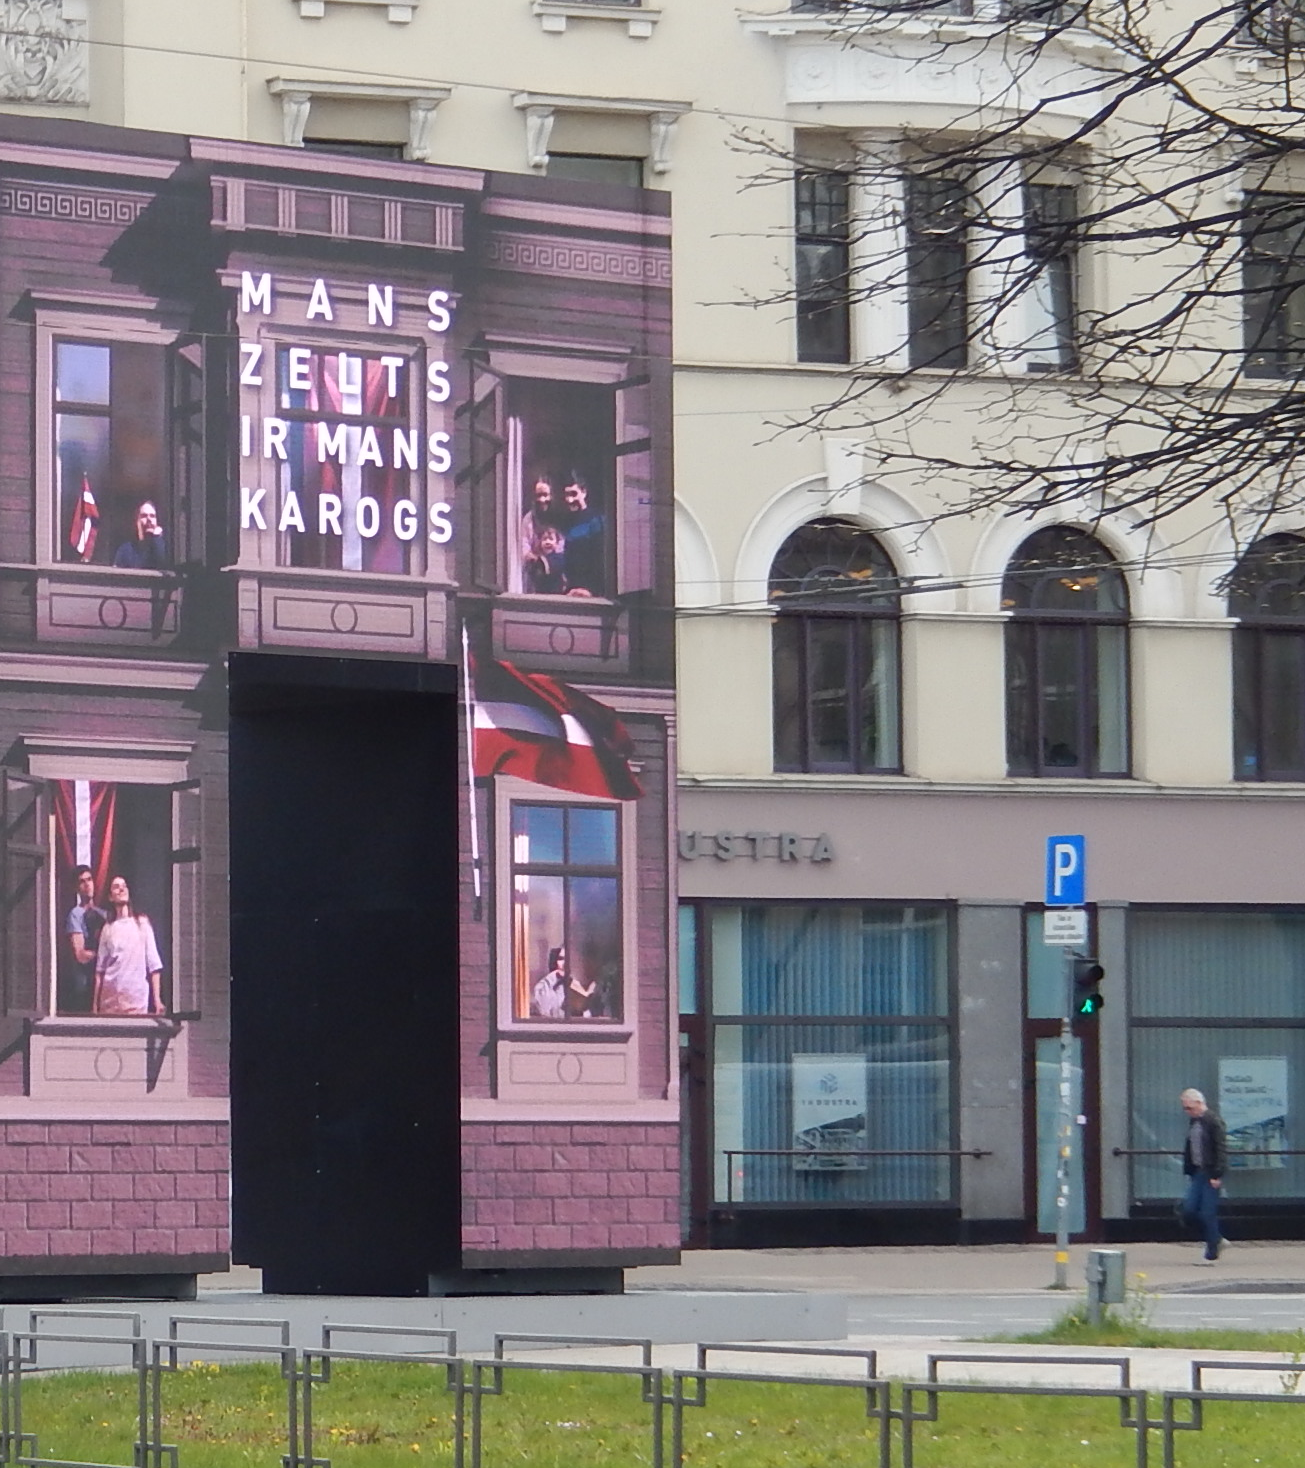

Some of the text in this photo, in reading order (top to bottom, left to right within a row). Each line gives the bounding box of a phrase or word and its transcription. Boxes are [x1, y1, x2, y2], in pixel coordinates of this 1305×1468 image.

[241, 271, 450, 331] MANS
[241, 343, 450, 402] ZELTS
[241, 415, 451, 472] IR MANS
[241, 487, 453, 543] KAROGS
[1054, 843, 1077, 896] P
